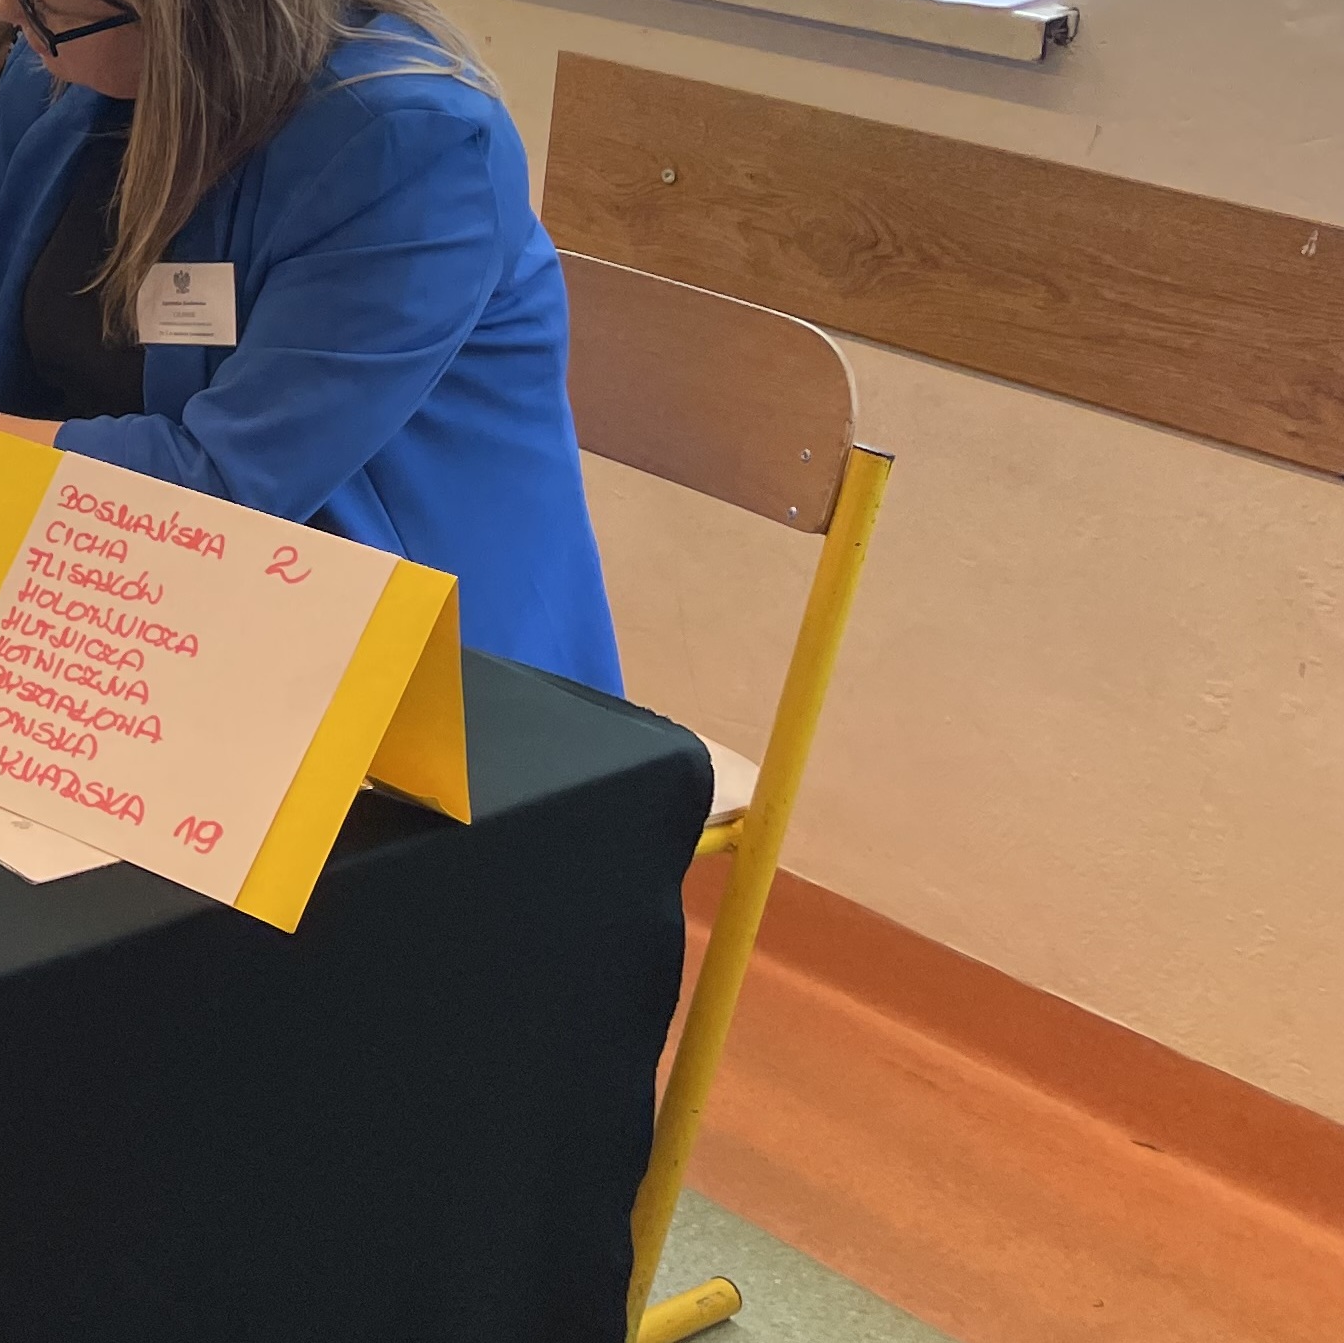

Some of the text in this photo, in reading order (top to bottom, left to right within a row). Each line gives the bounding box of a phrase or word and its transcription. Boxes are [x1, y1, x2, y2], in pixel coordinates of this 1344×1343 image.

[46, 520, 129, 564] CICHA
[57, 485, 312, 584] BOSMAŃSKA 2
[26, 547, 164, 605] FLISAKÓW
[1, 605, 145, 672] HUTNICZA
[173, 815, 224, 855] 19
